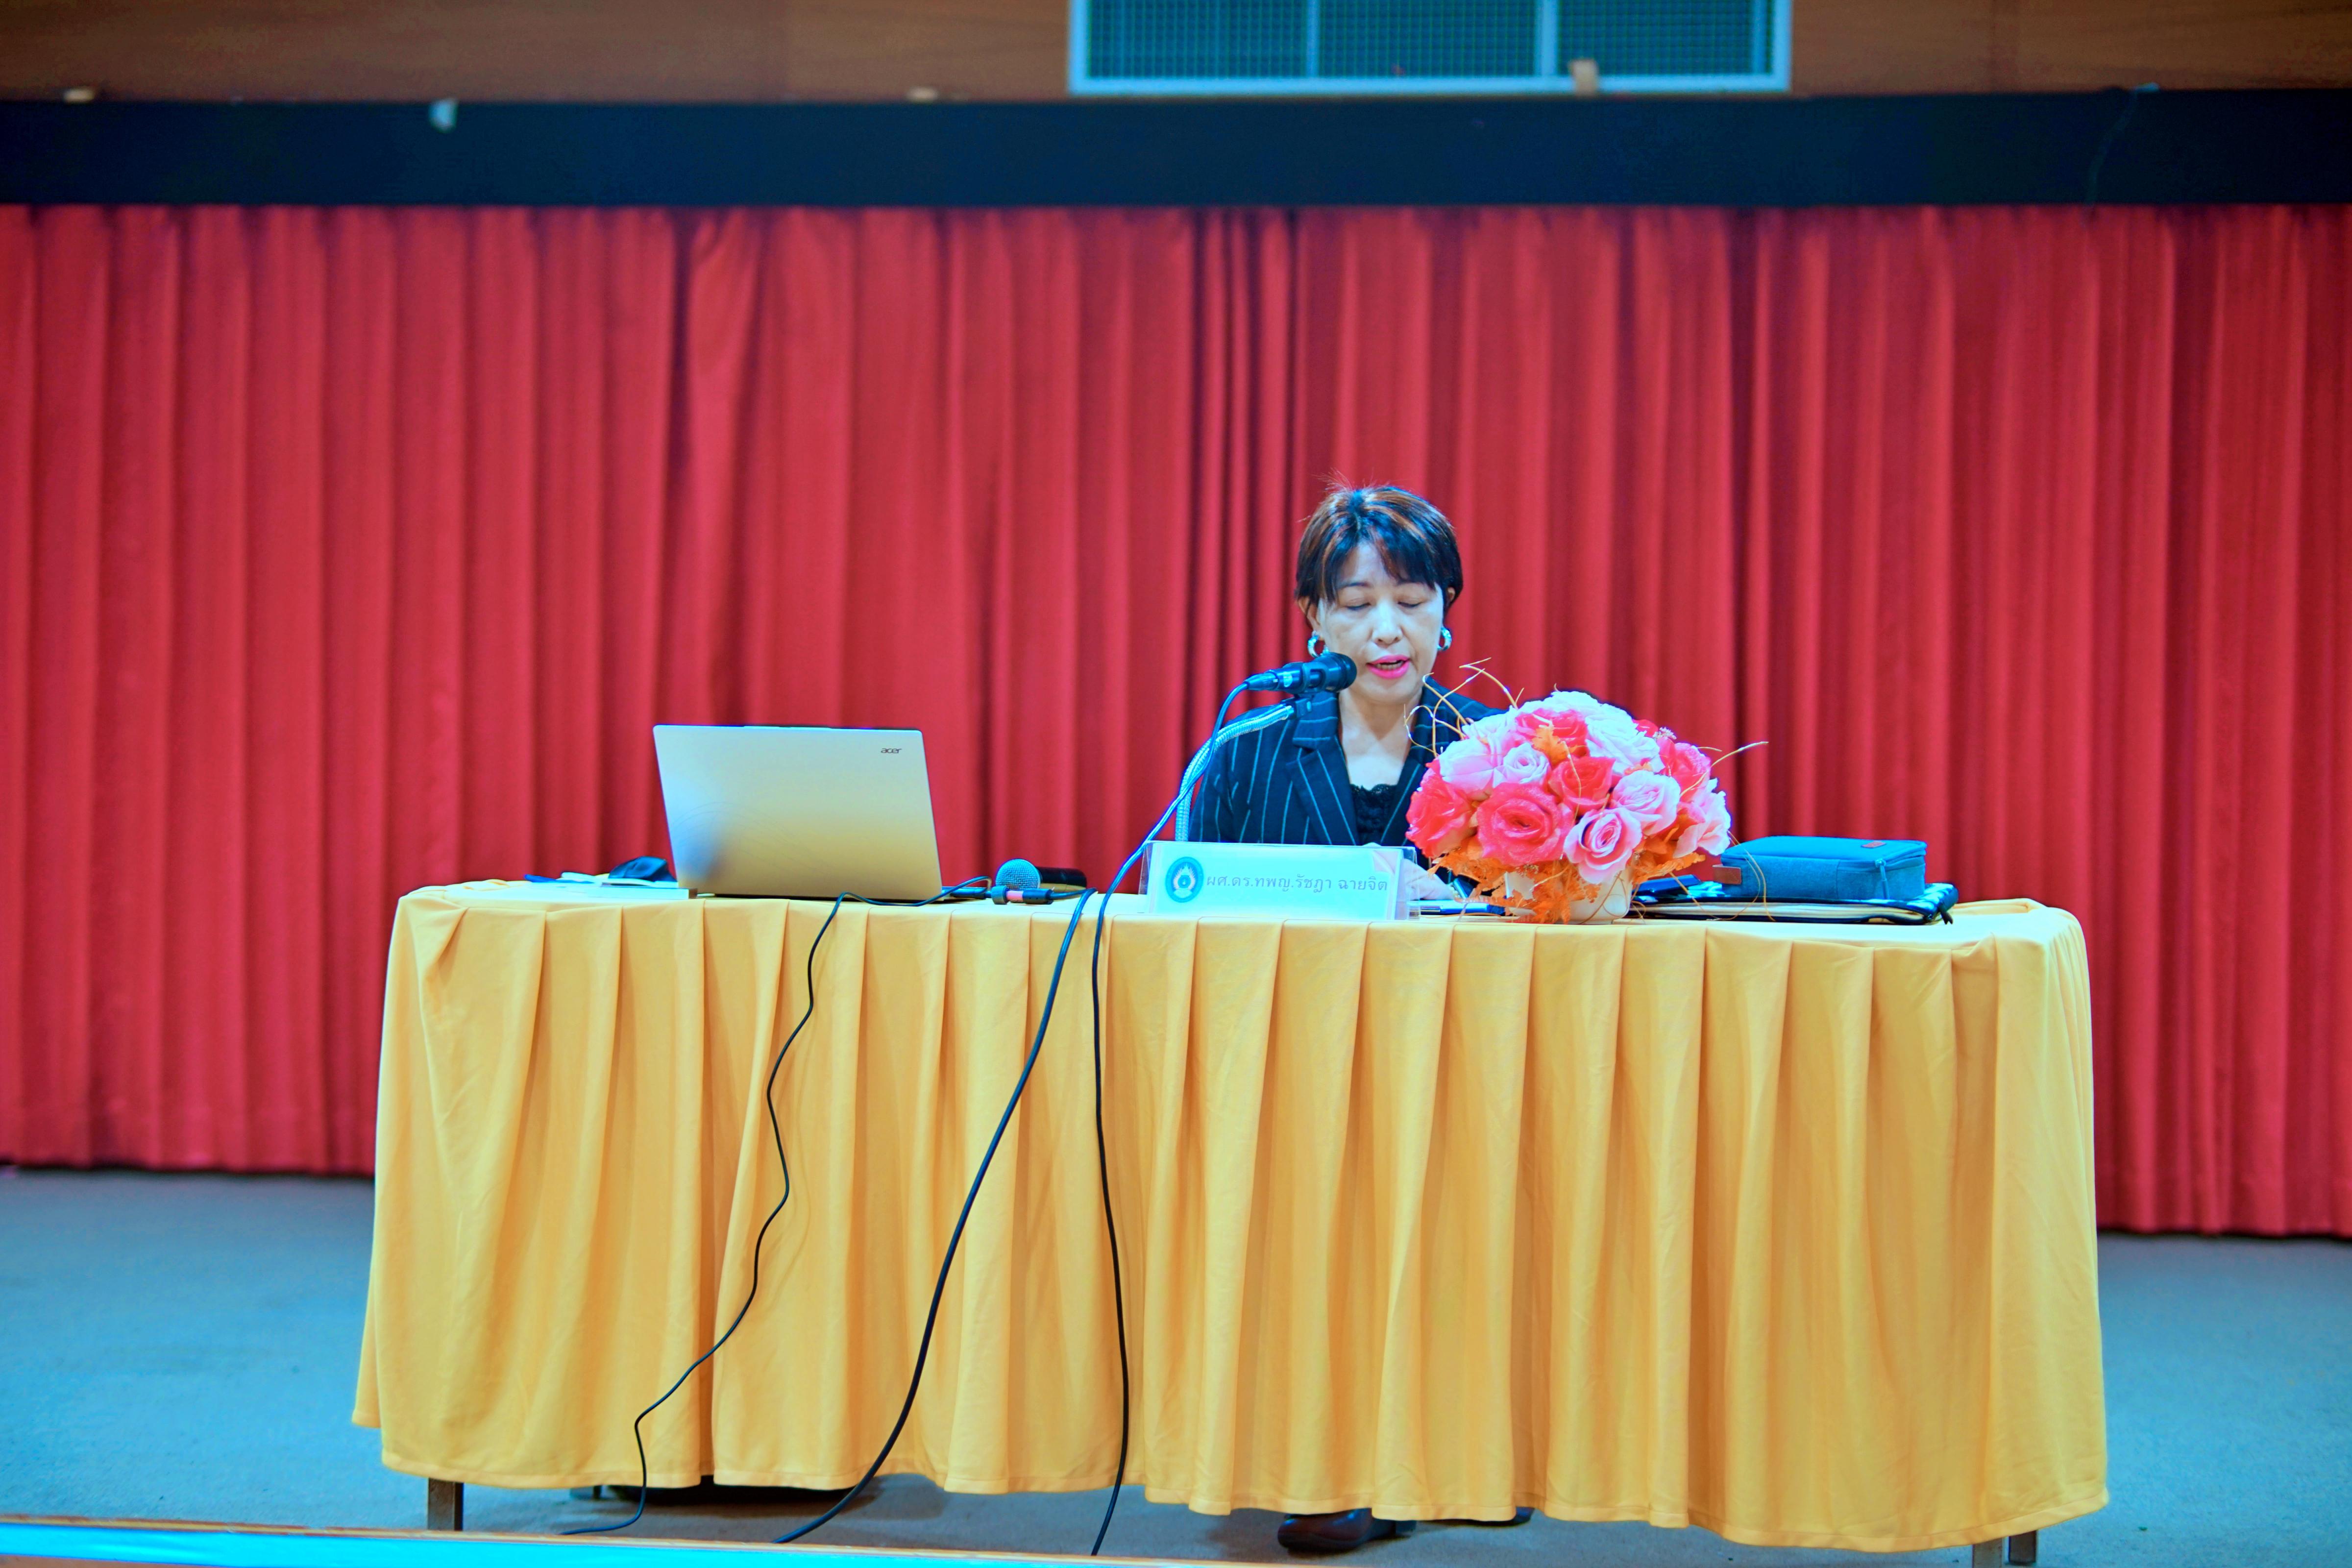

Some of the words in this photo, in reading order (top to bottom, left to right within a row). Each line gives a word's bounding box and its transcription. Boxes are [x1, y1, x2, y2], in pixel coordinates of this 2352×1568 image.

[1206, 874, 1331, 893] ผศ.ดร.ทพญ.รัชฎา
[1338, 876, 1388, 891] ฉายจิต
